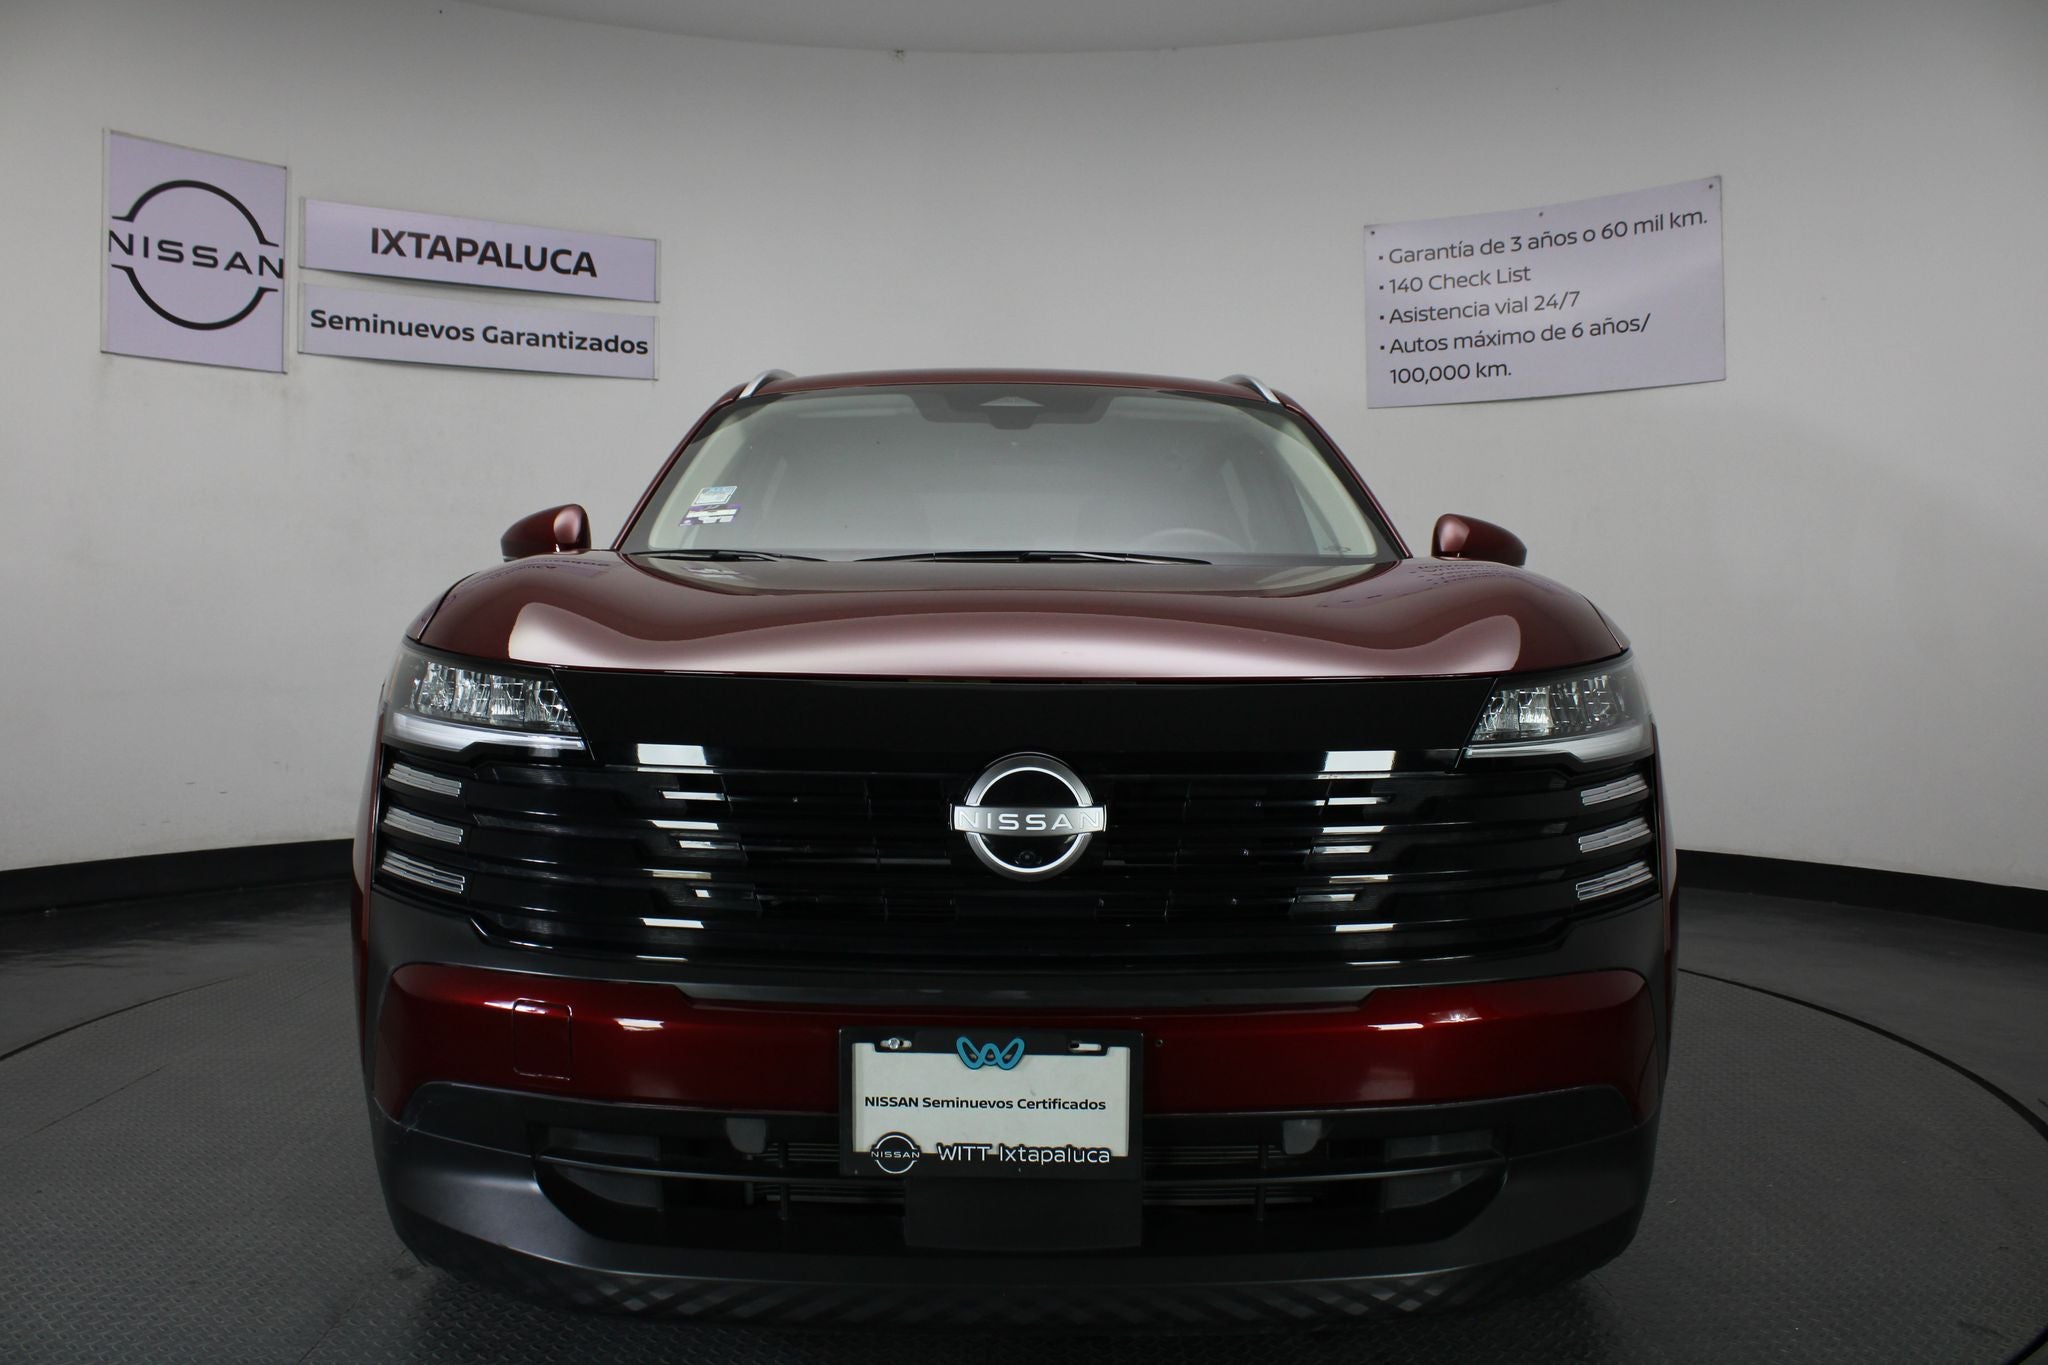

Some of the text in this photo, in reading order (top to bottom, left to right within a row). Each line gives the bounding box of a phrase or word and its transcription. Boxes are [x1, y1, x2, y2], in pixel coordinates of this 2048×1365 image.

[1388, 209, 1707, 264] Garantía de 3 años o 60 mil km.
[108, 230, 284, 279] NISSAN
[371, 227, 597, 278] IXTAPALUCA
[1389, 266, 1531, 293] 140 Check List
[1389, 291, 1580, 323] Asistencia vial 24/7
[310, 308, 648, 356] Seminuevos Garantizados
[1389, 313, 1651, 354] Autos máximo de 6 años/
[1390, 361, 1512, 385] 100,000 km.
[959, 811, 1099, 830] NISSAN
[865, 1097, 1106, 1110] NISSAN Seminuevos Certificados
[871, 1150, 919, 1158] NISSAN
[937, 1146, 1110, 1165] WITT Ixtapaluca
